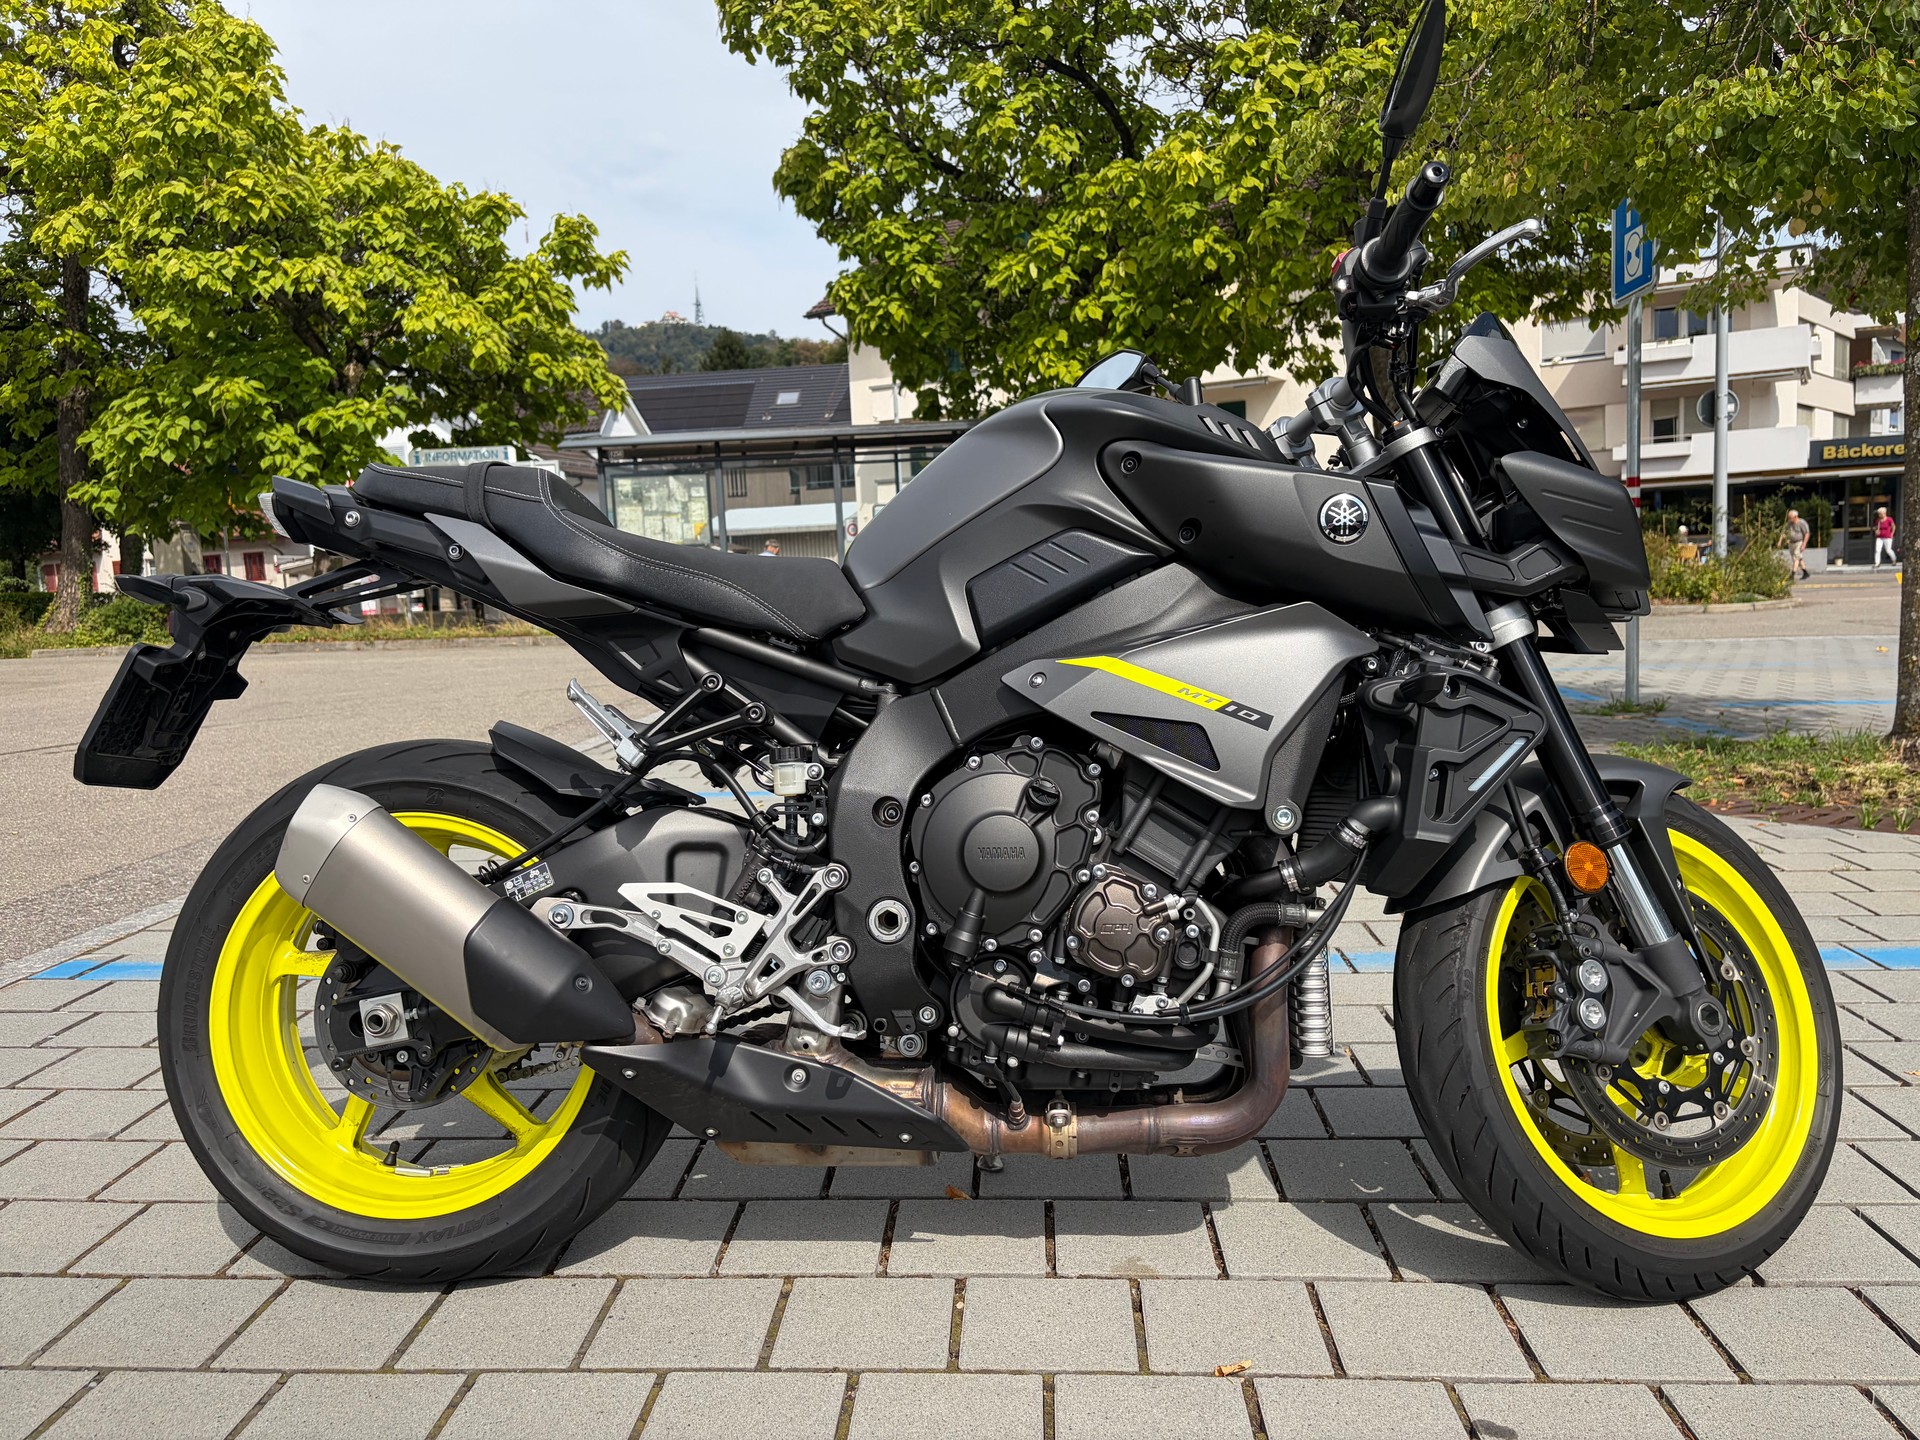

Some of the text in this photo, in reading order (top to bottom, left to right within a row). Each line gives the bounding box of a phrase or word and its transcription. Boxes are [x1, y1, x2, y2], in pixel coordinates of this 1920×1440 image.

[424, 449, 499, 463] INFORMATION
[1823, 443, 1905, 460] Bäckere
[977, 846, 1026, 860] YAMAHA
[182, 924, 217, 1053] BRIDGESTONE
[330, 1224, 401, 1242] HYPERSPORT
[415, 1211, 501, 1245] BATTLAX
